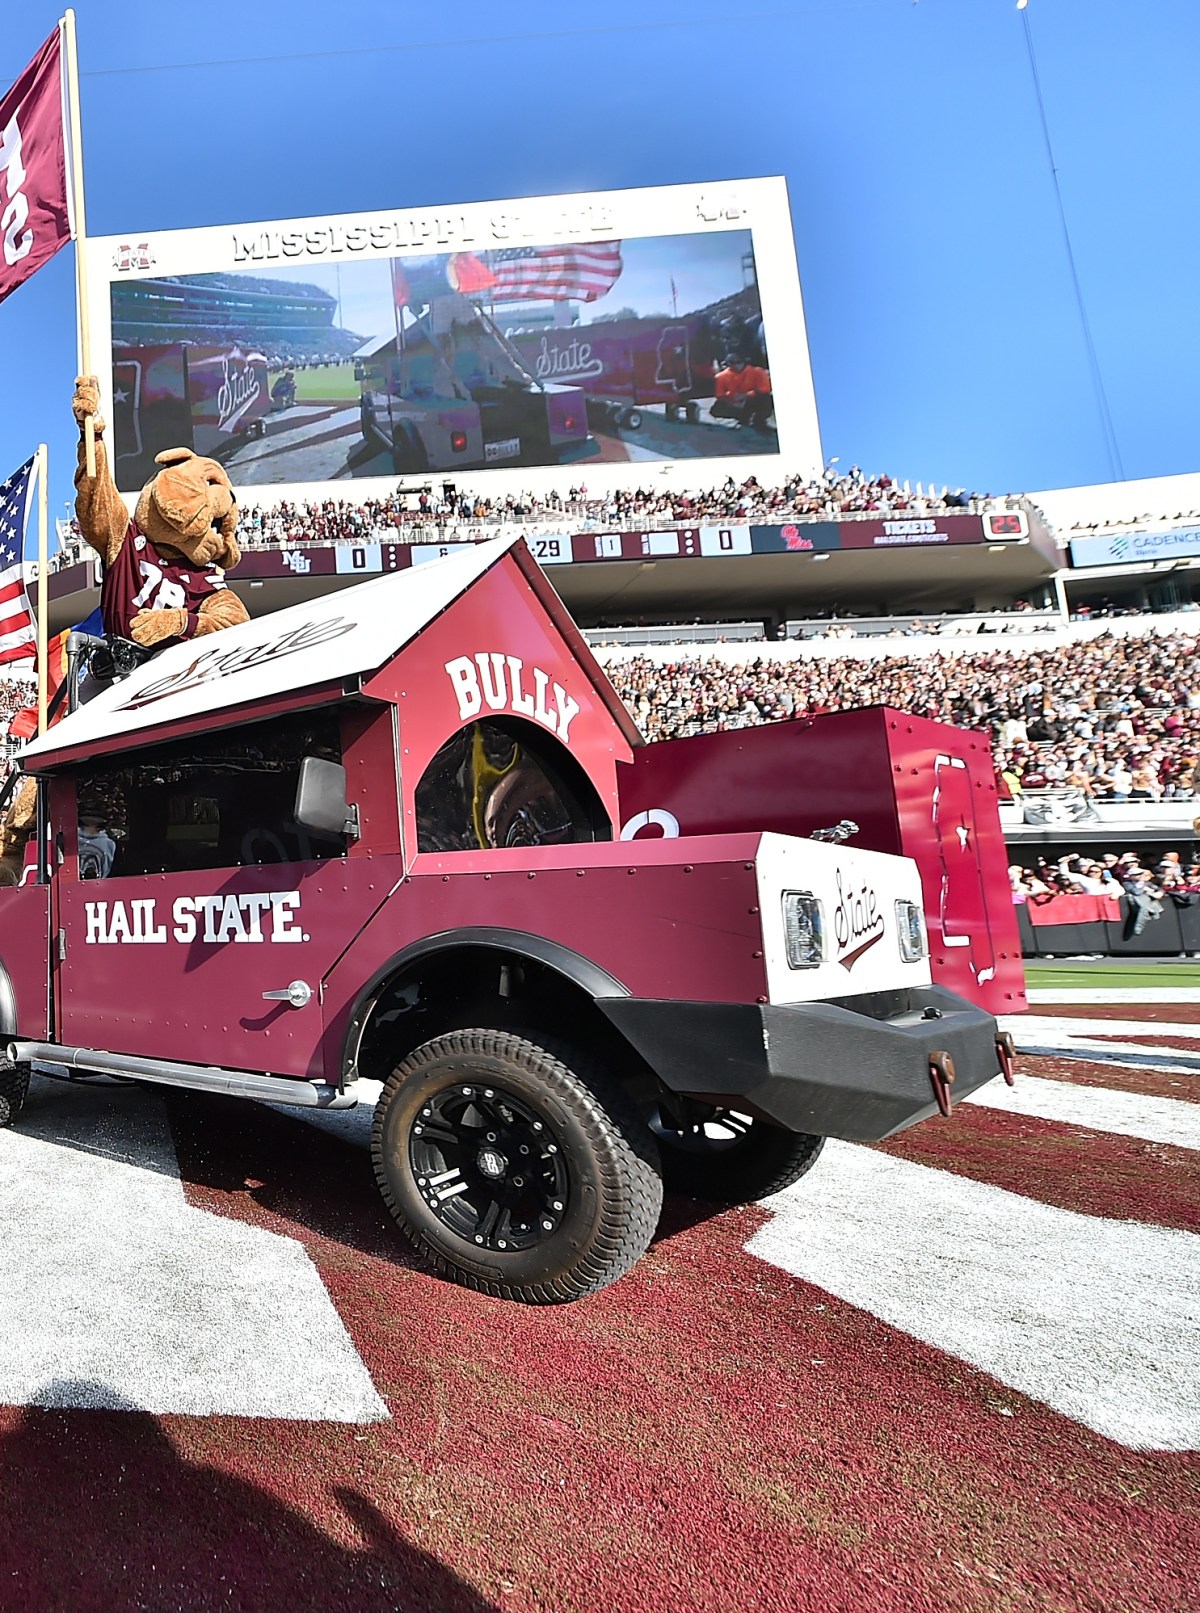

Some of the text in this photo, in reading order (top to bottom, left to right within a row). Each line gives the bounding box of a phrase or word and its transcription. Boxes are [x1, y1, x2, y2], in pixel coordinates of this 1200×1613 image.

[232, 215, 477, 262] MISSISSIPPI
[536, 336, 603, 384] State
[217, 358, 260, 432] State
[609, 540, 614, 551] 1
[718, 530, 733, 550] 0
[991, 515, 1022, 534] 25
[282, 550, 311, 573] MSU
[352, 548, 366, 569] 0
[109, 616, 358, 713] State
[445, 653, 580, 742] BULLY
[84, 898, 167, 944] HAIL
[834, 867, 885, 973] State
